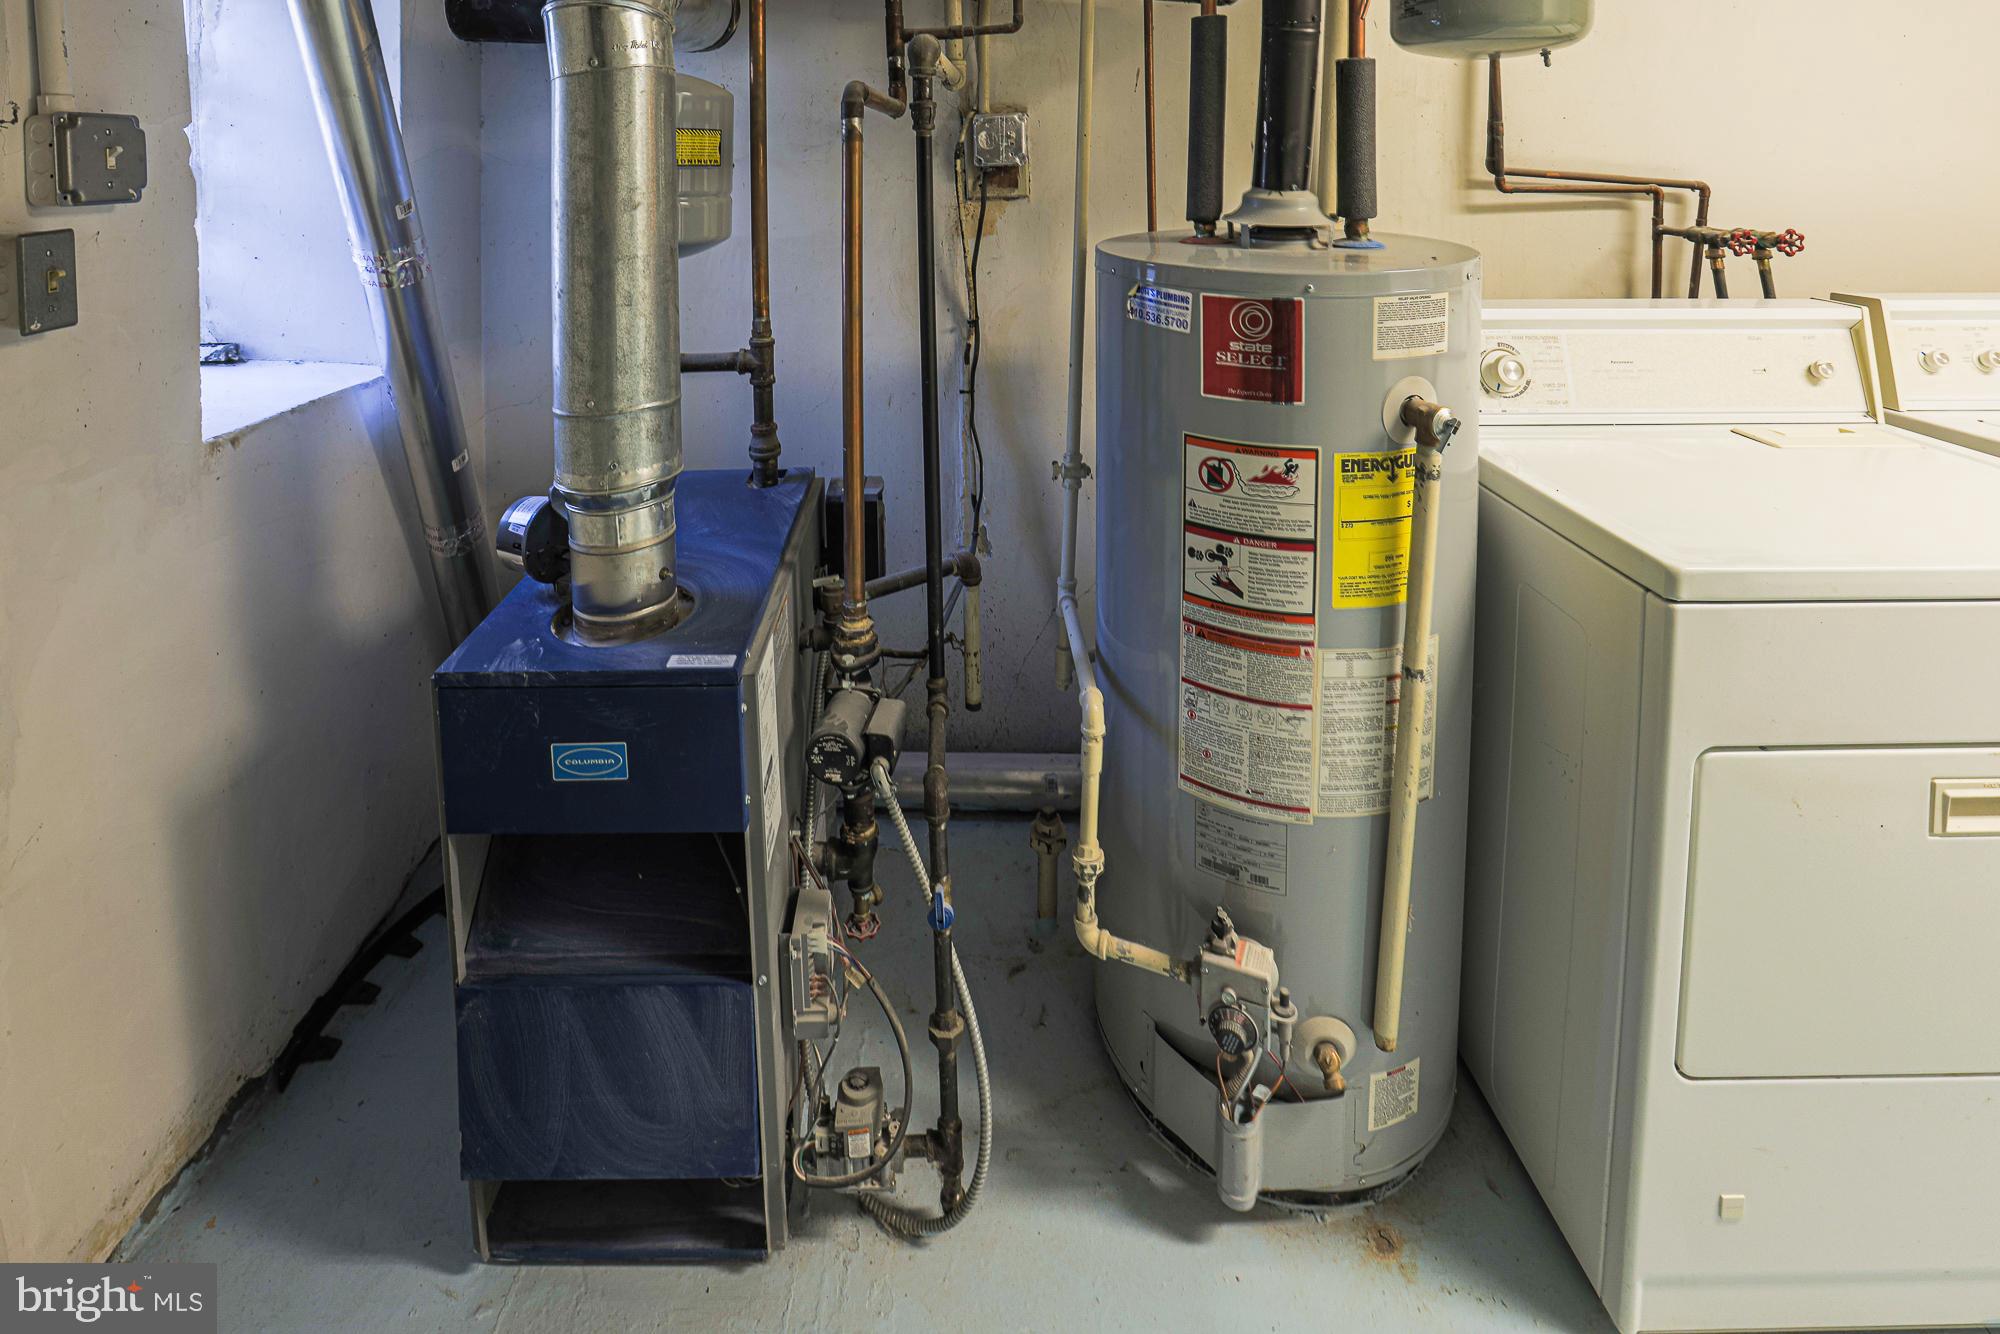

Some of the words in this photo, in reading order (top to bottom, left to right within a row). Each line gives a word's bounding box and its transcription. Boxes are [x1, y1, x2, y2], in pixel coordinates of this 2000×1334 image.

[1156, 289, 1190, 306] PLUMBING
[1229, 341, 1272, 354] state
[1216, 351, 1288, 367] SELECT
[1241, 447, 1280, 458] WARNING
[1243, 539, 1278, 549] DANGER
